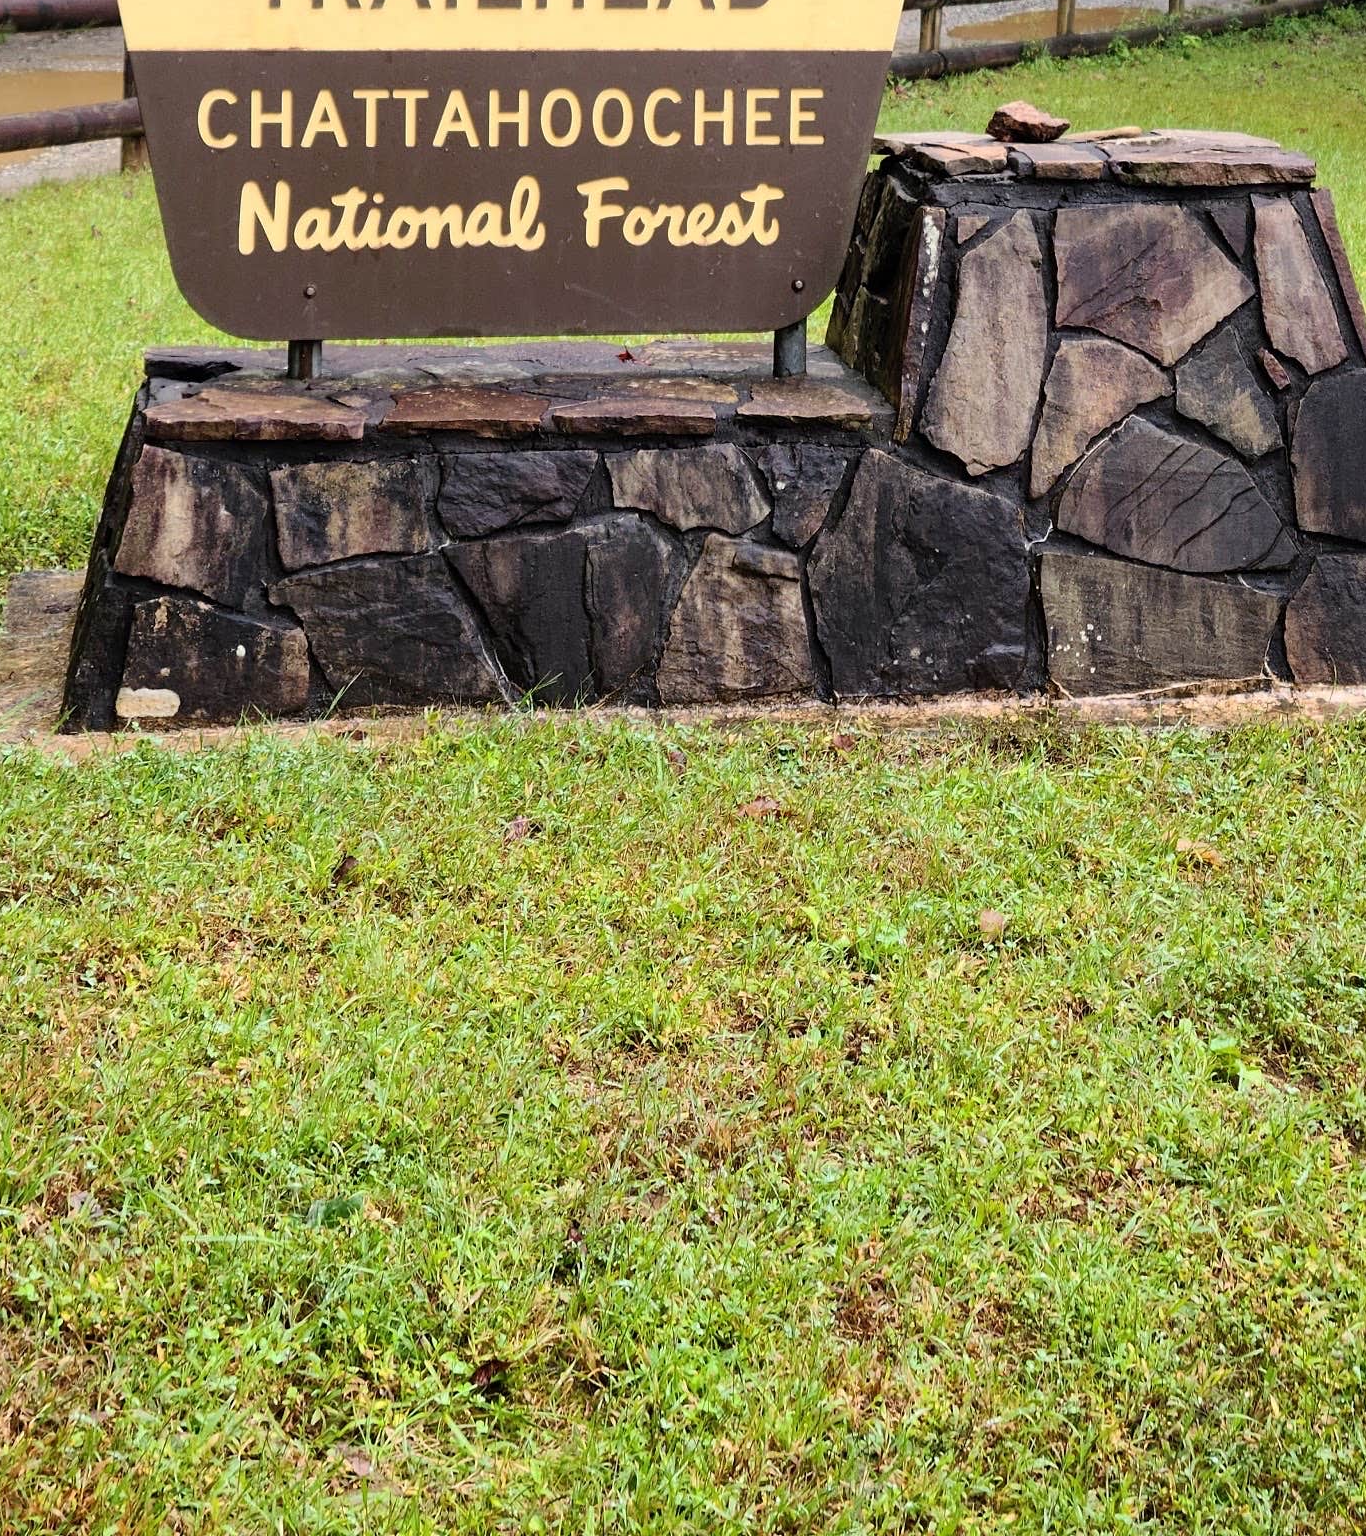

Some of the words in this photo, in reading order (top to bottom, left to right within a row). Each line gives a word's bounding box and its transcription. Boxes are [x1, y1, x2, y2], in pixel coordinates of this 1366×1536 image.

[196, 87, 825, 150] CHATTAHOOCHEE
[237, 174, 547, 256] National
[575, 175, 785, 250] Forest
